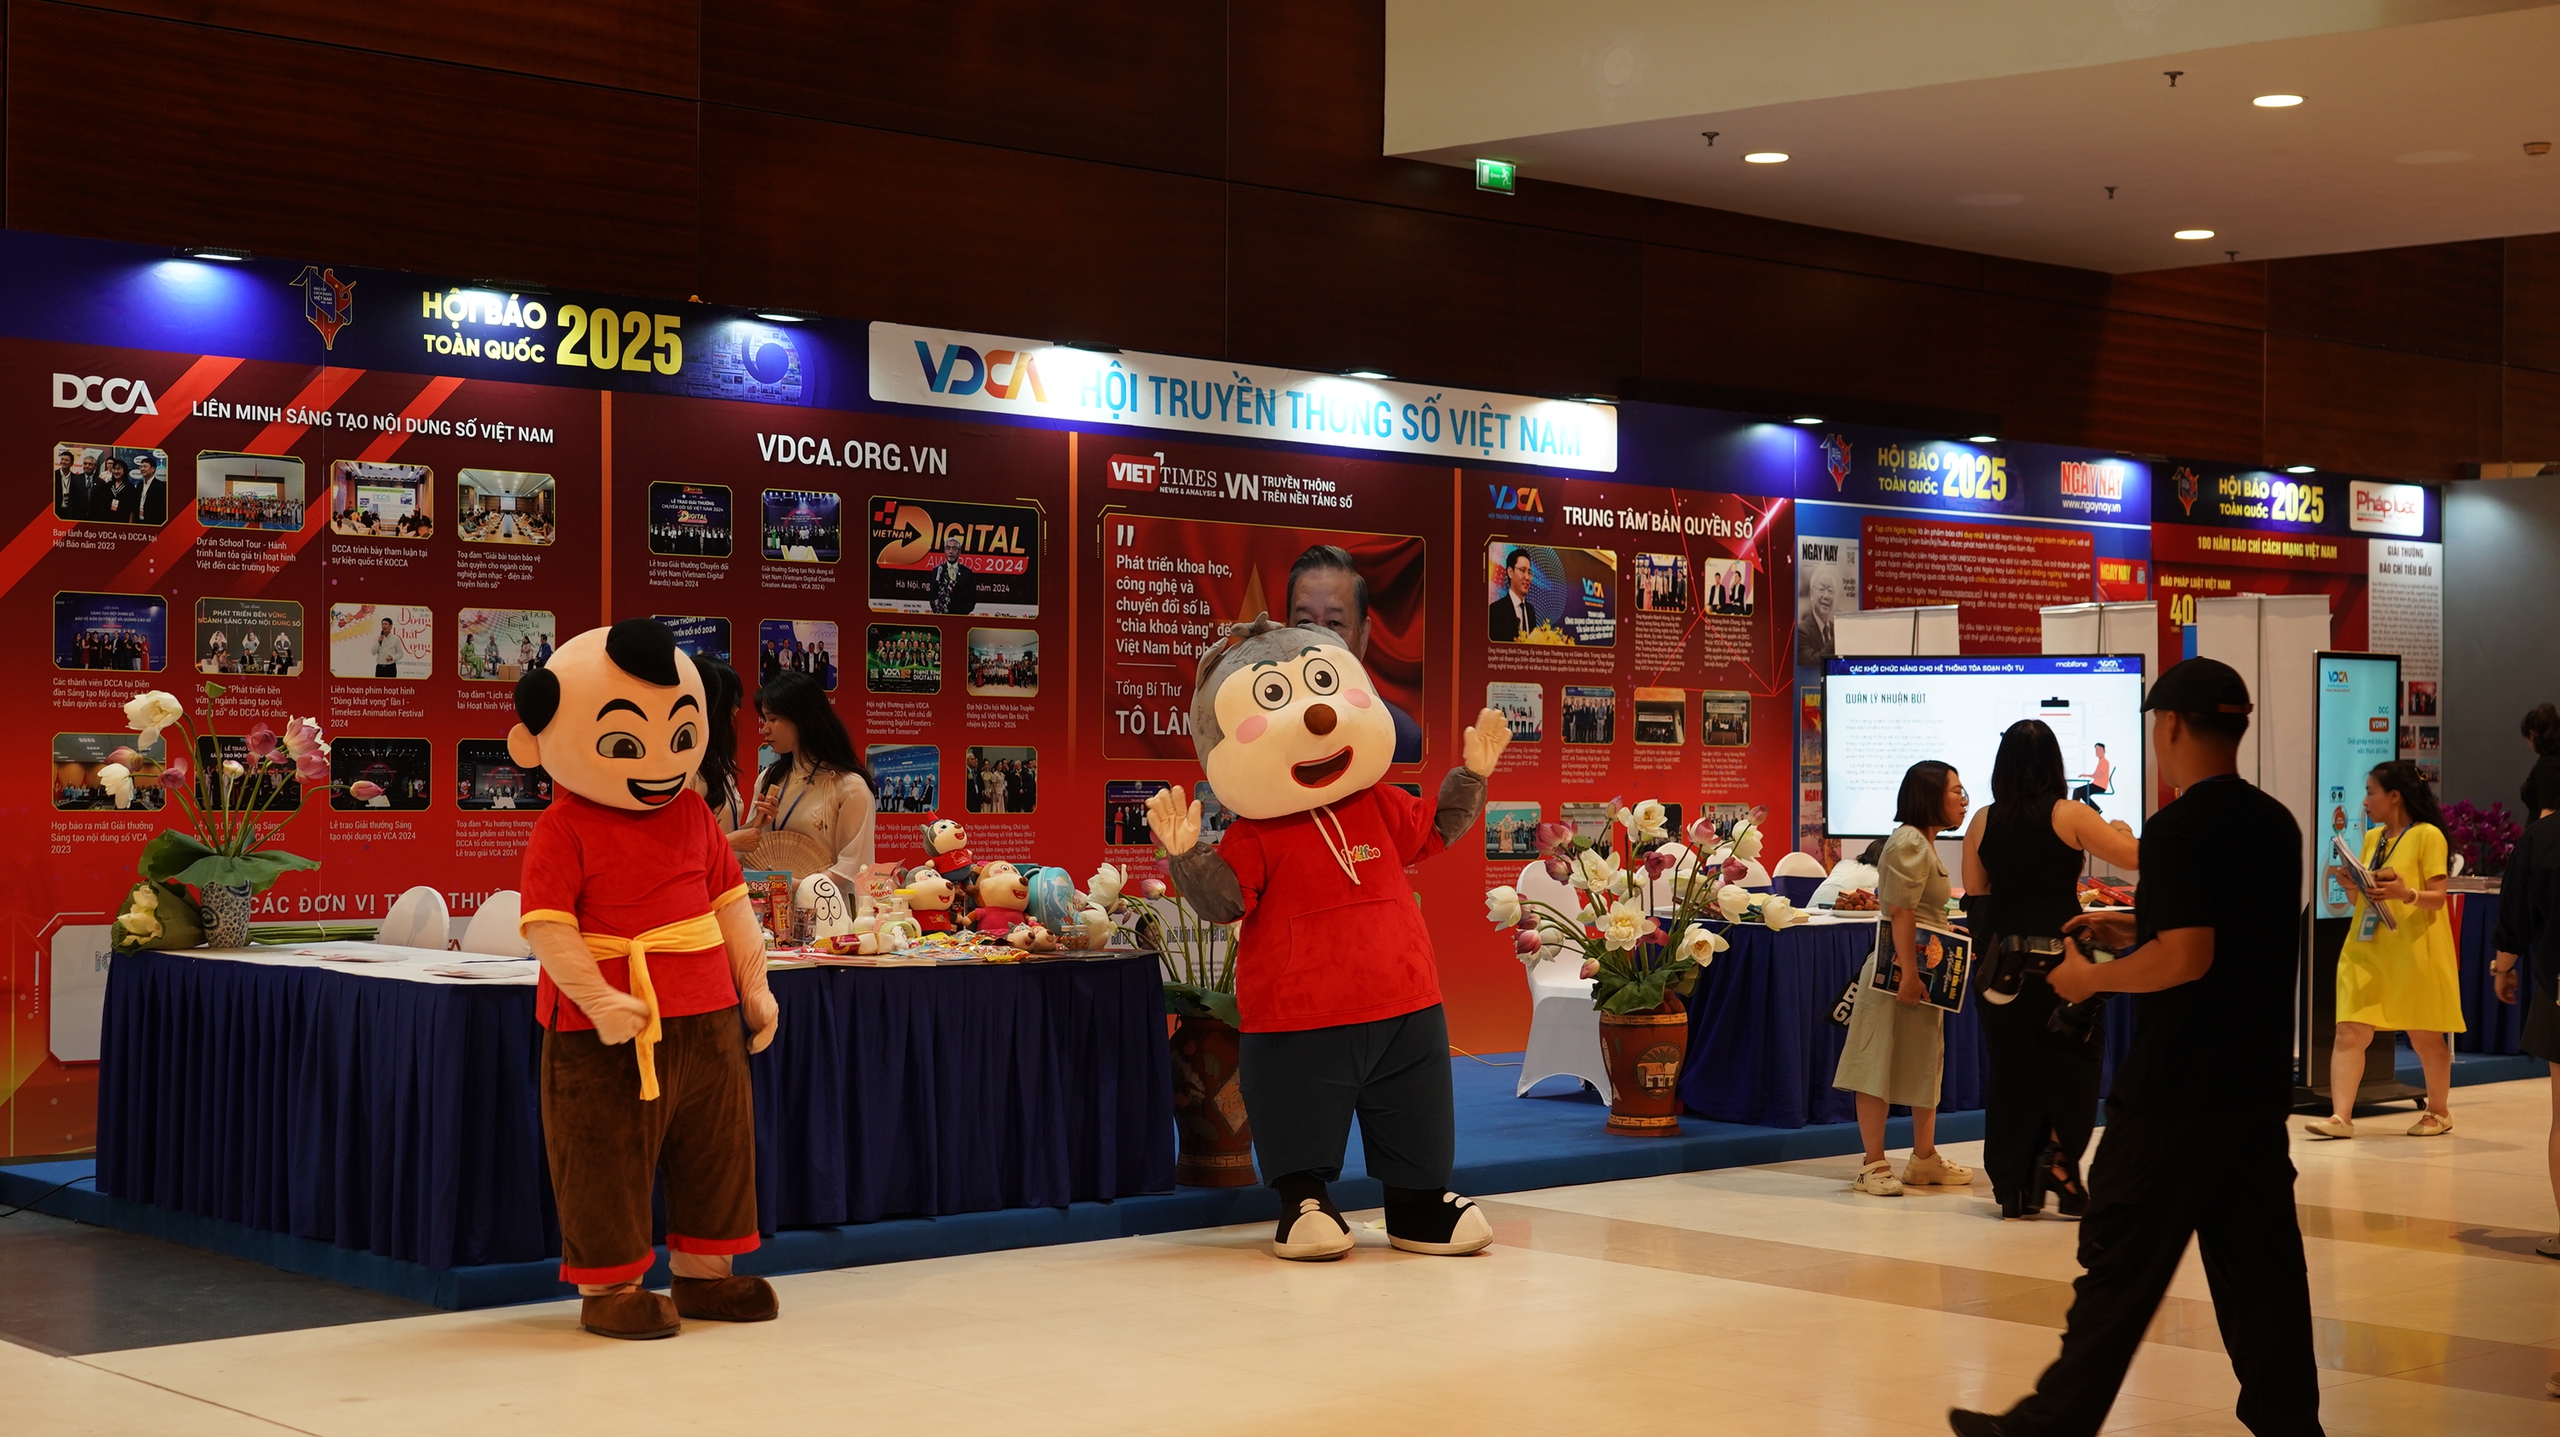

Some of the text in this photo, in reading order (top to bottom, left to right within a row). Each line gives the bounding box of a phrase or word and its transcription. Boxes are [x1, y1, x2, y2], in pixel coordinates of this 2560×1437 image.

[422, 287, 546, 330] HỘI BÁO
[424, 333, 545, 363] TOÀN QUỐC
[556, 304, 683, 375] 2025
[53, 372, 158, 415] DCCA
[914, 340, 1046, 402] VDCA
[1081, 360, 1138, 420] HỘI
[1149, 370, 1277, 428] TRUYỀN
[1401, 394, 1441, 443] SỐ
[1448, 400, 1511, 455] VIỆT
[1521, 415, 1581, 456] NAM
[193, 398, 553, 444] LIÊN MINH SÁNG TẠO NỘI DUNG SỐ VIỆT NAM
[758, 432, 946, 476] VDCA.ORG.VN
[1878, 444, 1939, 472] HỘI BÁO
[1112, 462, 1155, 484] VIET
[1160, 467, 1217, 488] TIMES
[1262, 474, 1336, 492] TRUYỀN THÔNG
[1879, 474, 1938, 494] TOÀN QUỐC
[1943, 452, 2006, 501] 2025
[2099, 466, 2124, 499] NAY
[1186, 488, 1216, 497] ANALYSIS
[2219, 475, 2270, 500] HỘI BÁO
[1262, 489, 1353, 508] TRÊN NỀN TẢNG SỐ
[1490, 485, 1543, 512] VDCA
[2062, 500, 2121, 514] www.ngaynay.vn
[2271, 481, 2324, 524] 2025
[2220, 500, 2268, 520] TOÀN QUỐC
[1563, 506, 1753, 539] TRUNG TÂM BẢN QUYỀN SỐ
[53, 529, 157, 543] Ban lãnh đạo VDCA và DCCA tại
[53, 539, 115, 550] Hội Báo năm 2023
[873, 529, 912, 539] VIETNAM
[877, 506, 1025, 564] DIGITAL
[332, 544, 428, 557] DCCA trình bày tham luận tại
[2198, 537, 2337, 560] 100 NĂM BÁO CHÍ CÁCH MẠNG VIỆT NAM
[332, 557, 341, 565] sự
[342, 558, 356, 566] kiện
[358, 556, 374, 567] quốc
[376, 556, 383, 566] tế
[985, 558, 1023, 572] 2024
[1116, 554, 1233, 578] Phát triển khoa học,
[1116, 576, 1194, 596] công nghệ và
[2161, 575, 2231, 591] BÁO PHÁP LUẬT VIỆT NAM
[1116, 596, 1210, 616] chuyển đổi số là
[2170, 594, 2194, 625] 40
[1149, 619, 1178, 635] khoá
[1216, 621, 1231, 637] để
[1116, 638, 1140, 656] Việt
[1143, 641, 1170, 654] Nam
[1850, 664, 1862, 672] CÁC
[1934, 663, 1943, 673] HỆ
[2328, 671, 2348, 683] VDCA
[1116, 679, 1182, 699] Tổng Bí Thư
[1846, 692, 1926, 706] QUẢN LÝ NHUẬN BÚT
[1116, 704, 1145, 734] TÔ
[250, 892, 374, 915] CÁC ĐƠN VỊ
